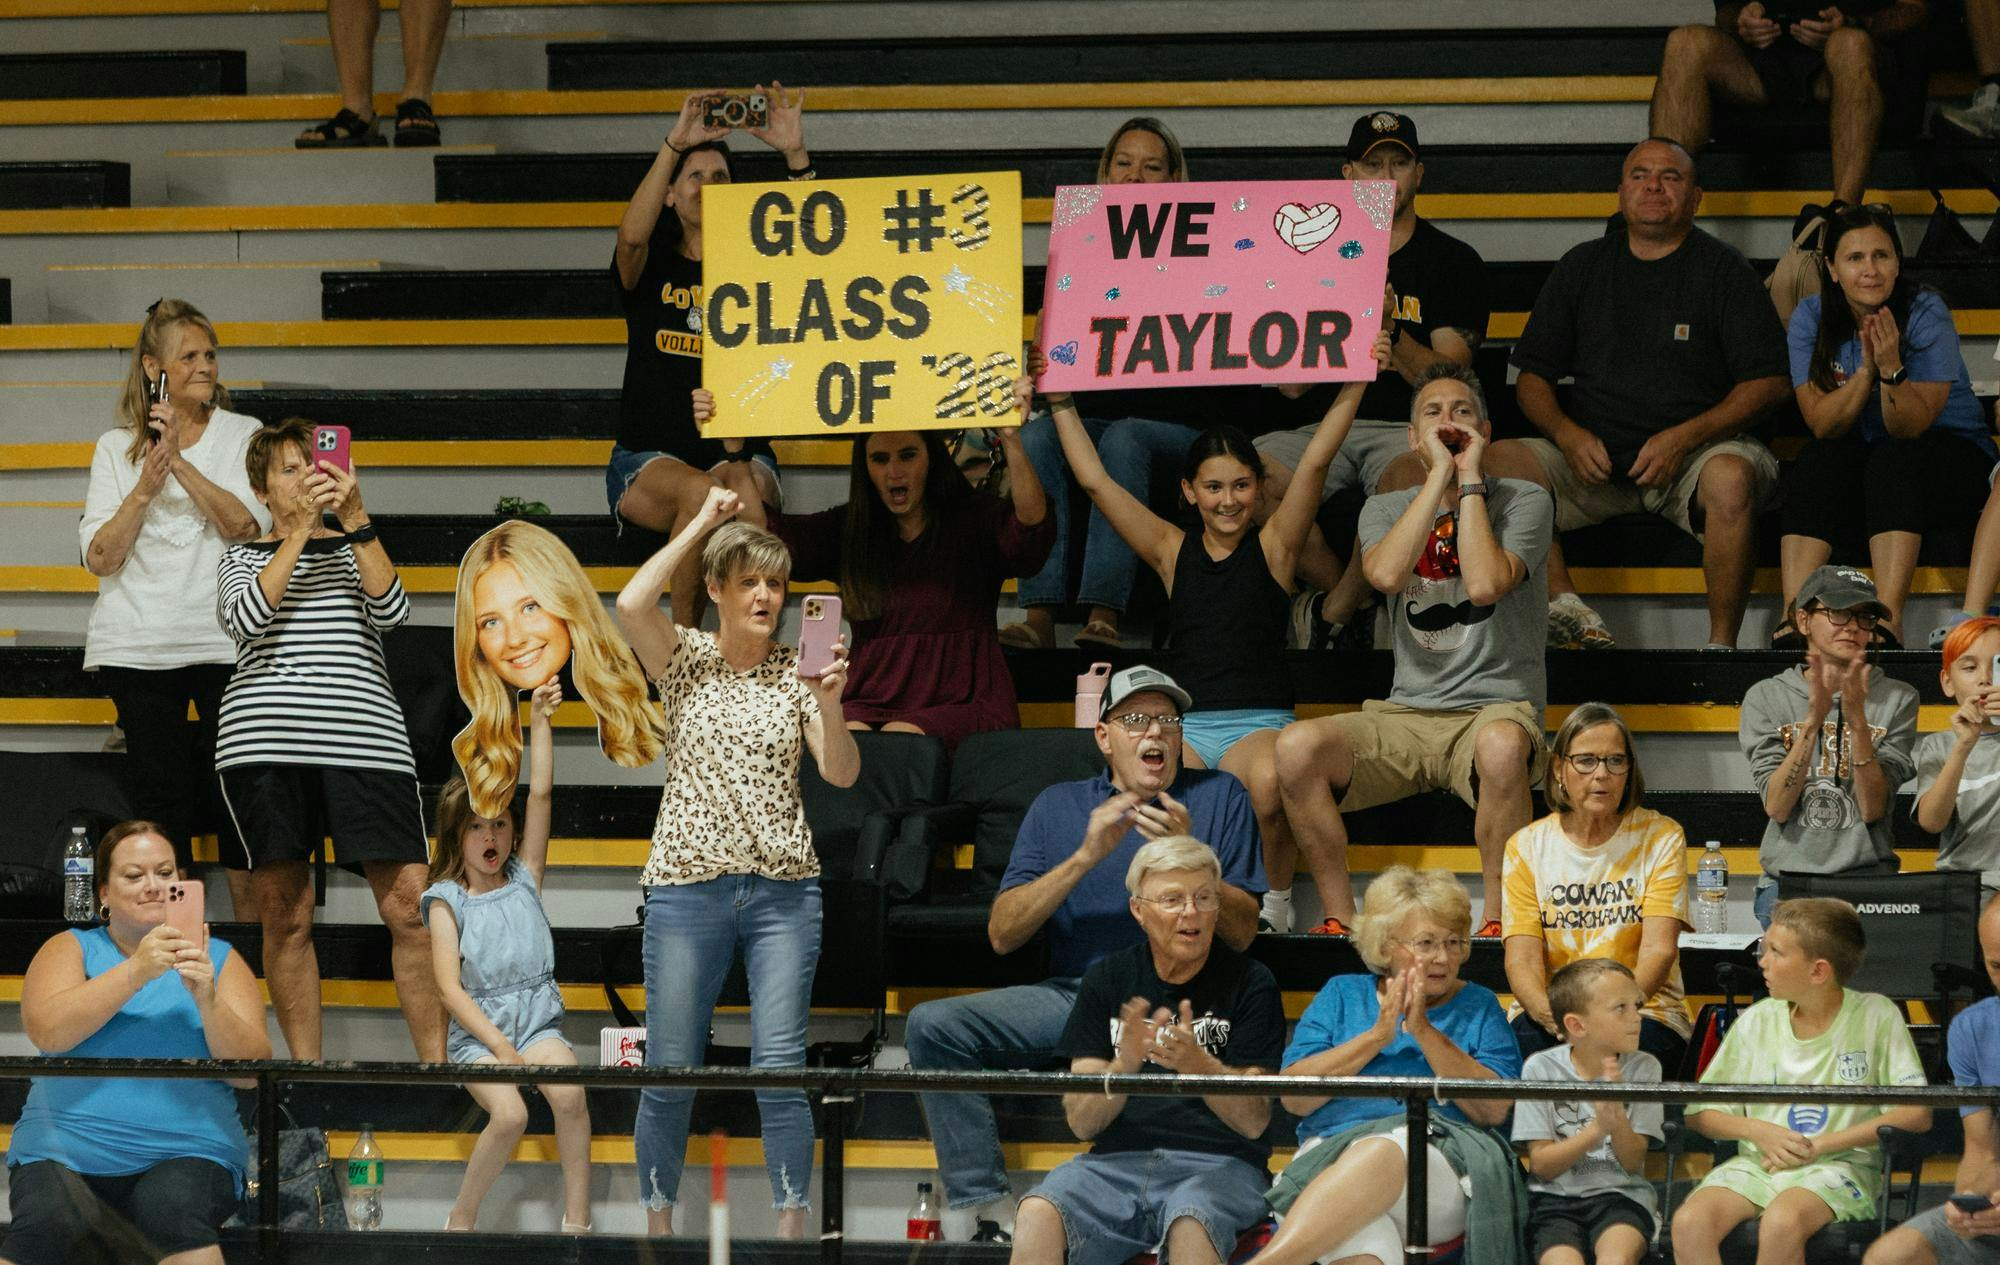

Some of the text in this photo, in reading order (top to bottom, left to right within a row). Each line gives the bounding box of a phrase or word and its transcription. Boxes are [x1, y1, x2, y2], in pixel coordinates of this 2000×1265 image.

[749, 183, 993, 257] GO #3
[1106, 202, 1216, 260] WE
[706, 274, 932, 350] CLASS
[1089, 310, 1353, 378] TAYLOR
[815, 351, 1018, 427] OF '26
[1540, 904, 1643, 929] LACKHAWK
[1551, 878, 1634, 907] COWAN
[1856, 903, 1920, 914] ADVENOR
